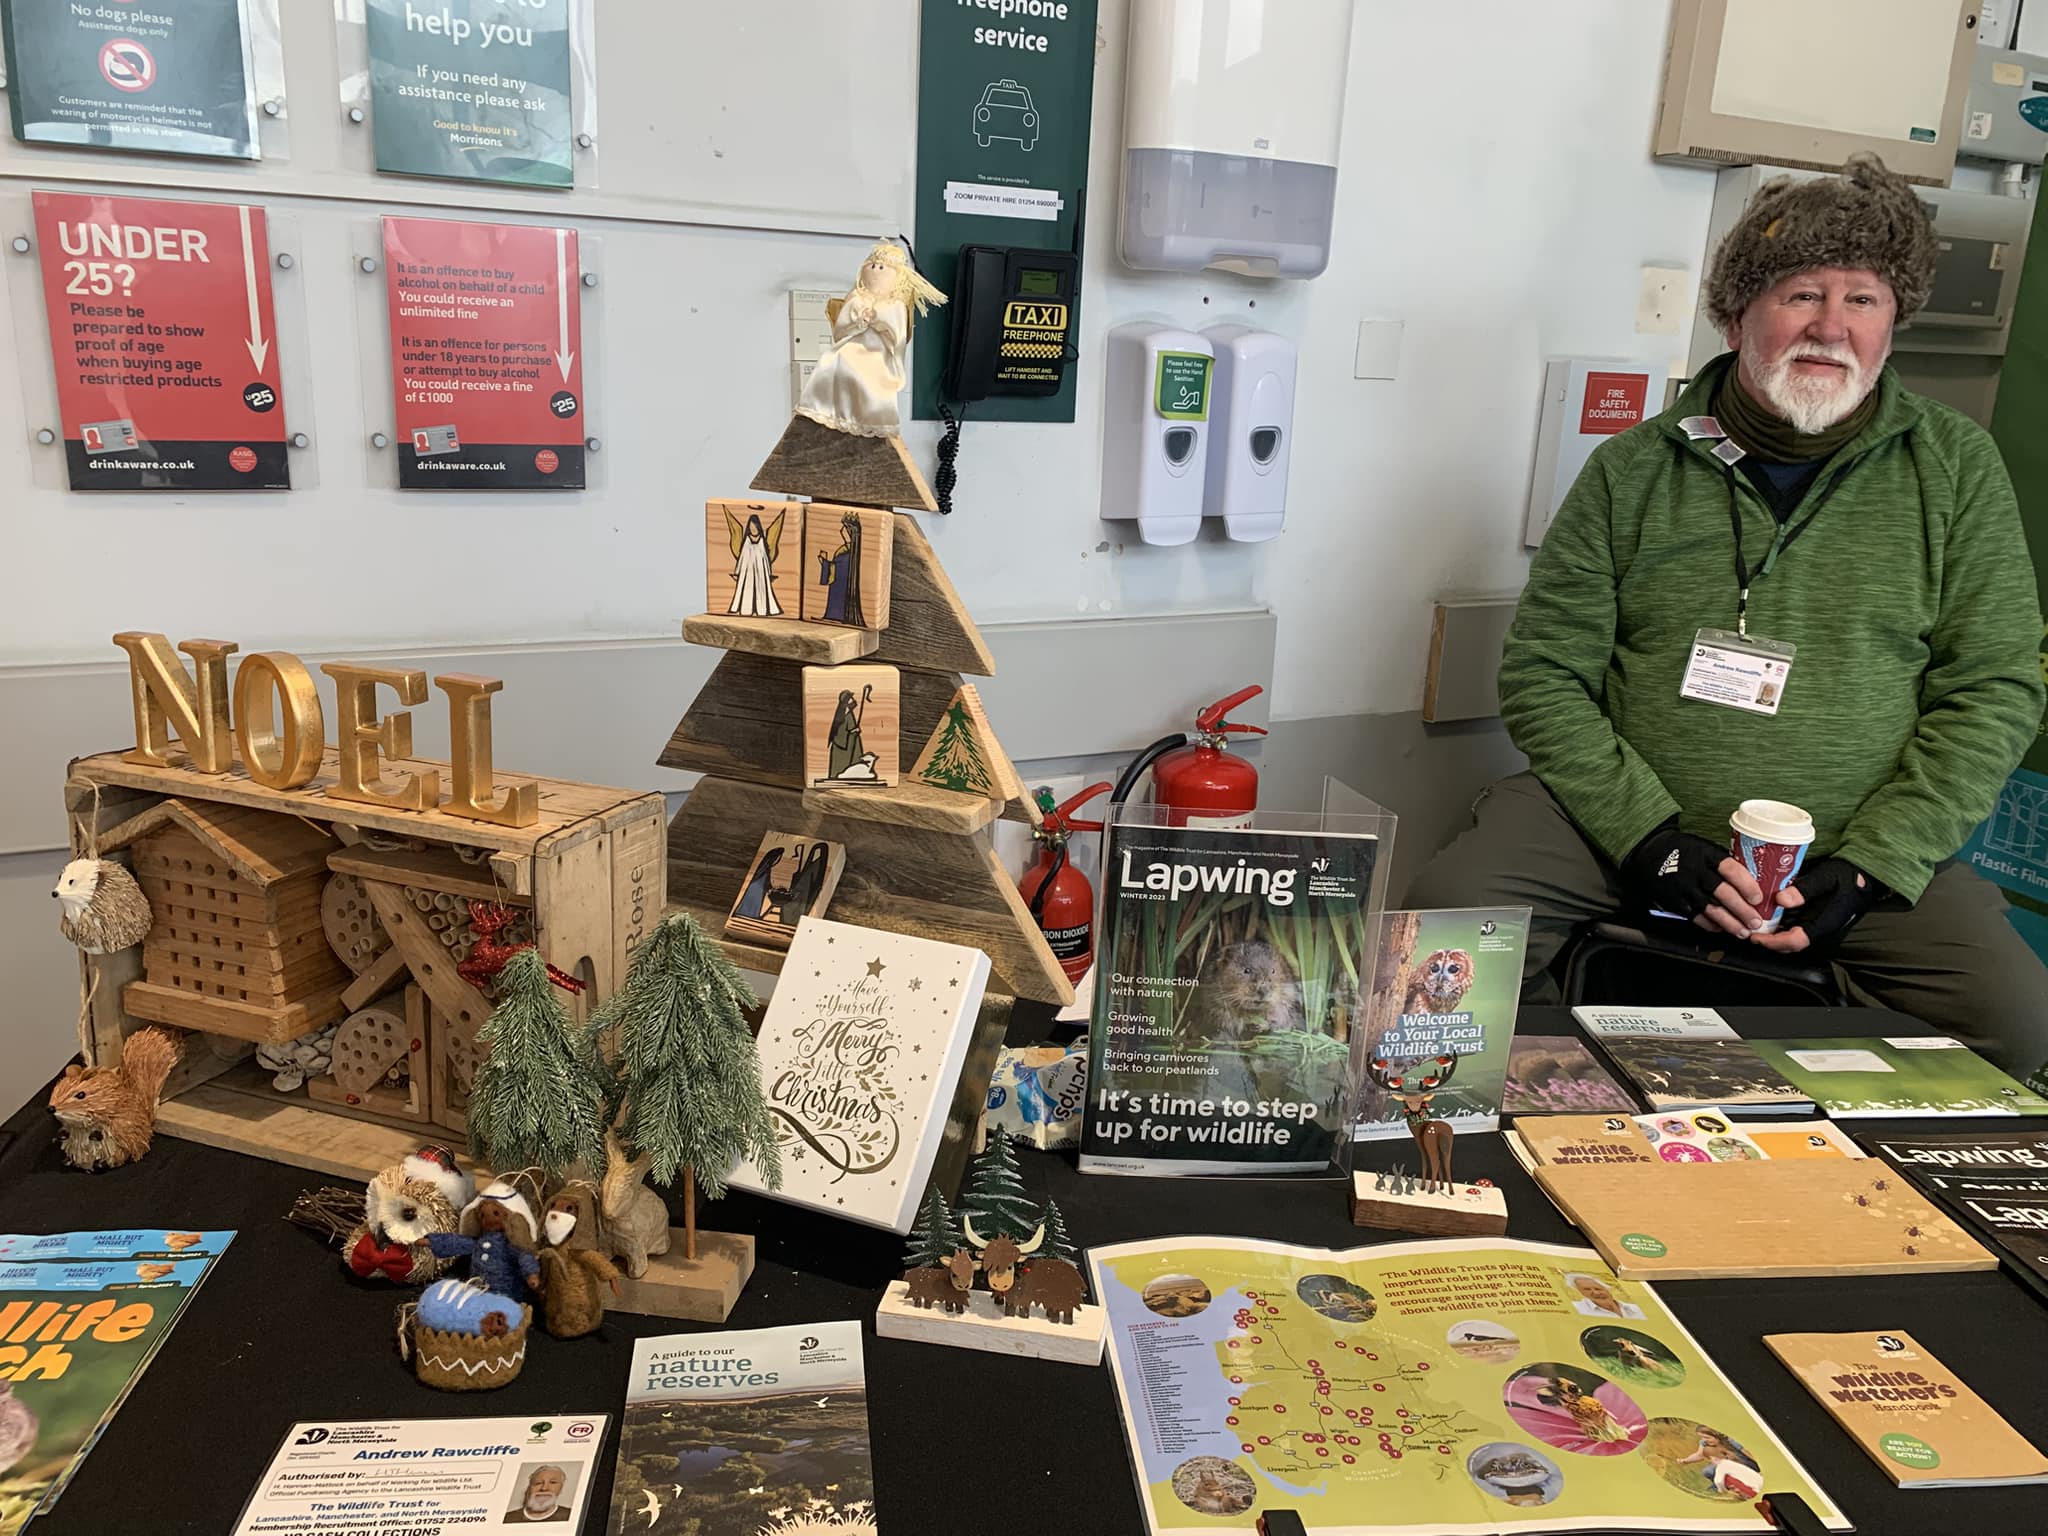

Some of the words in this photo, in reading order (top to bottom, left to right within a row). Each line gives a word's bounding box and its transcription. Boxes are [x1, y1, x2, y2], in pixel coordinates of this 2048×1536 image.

[71, 4, 91, 16] No
[95, 5, 127, 22] dogs
[131, 9, 173, 26] please
[78, 20, 124, 32] Assistance
[126, 24, 148, 36] dogs
[149, 28, 169, 39] only
[405, 3, 471, 46] help
[480, 21, 533, 48] you
[974, 26, 1049, 52] service
[416, 64, 428, 78] If
[431, 67, 459, 83] you
[463, 72, 498, 87] need
[502, 77, 527, 94] any
[398, 83, 472, 103] assistance
[475, 91, 520, 109] please
[524, 98, 546, 111] ask
[58, 95, 107, 108] Customers
[109, 100, 123, 109] are
[124, 101, 167, 114] reminded
[168, 105, 186, 115] that
[188, 107, 203, 117] the
[450, 133, 503, 147] Morrisons
[954, 192, 974, 201] ZOOM
[974, 194, 1001, 203] PRIVATE
[1002, 196, 1017, 205] HIRE
[59, 221, 210, 263] UNDER
[63, 261, 136, 297] 25?
[398, 291, 421, 303] You
[423, 292, 455, 305] could
[457, 294, 498, 307] receive
[500, 298, 514, 308] an
[70, 302, 123, 318] Please
[126, 304, 145, 319] be
[400, 306, 455, 319] unlimited
[456, 308, 479, 320] fine
[1013, 306, 1059, 325] TAXI
[72, 320, 144, 338] prepared
[147, 324, 162, 337] to
[165, 324, 205, 338] show
[1003, 330, 1064, 341] FREEPHONE
[75, 338, 116, 354] proof
[119, 339, 134, 352] of
[137, 343, 165, 355] age
[402, 336, 410, 347] It
[412, 338, 421, 348] is
[424, 339, 439, 349] an
[441, 337, 482, 350] offence
[484, 339, 500, 351] for
[503, 342, 547, 355] persons
[77, 356, 119, 369] when
[122, 357, 172, 372] buying
[175, 360, 203, 373] age
[79, 373, 154, 387] restricted
[157, 373, 223, 390] products
[1607, 389, 1625, 399] FIRE
[1599, 399, 1630, 409] SAFETY
[1588, 409, 1638, 420] DOCUMENTS
[89, 458, 195, 471] drinkaware.co.uk
[417, 461, 506, 472] drinkaware.co.uk
[113, 631, 538, 828] NOEL
[1971, 851, 2018, 877] Plastic
[1121, 849, 1298, 907] Lapwing
[1120, 892, 1148, 901] WINTER
[1044, 930, 1061, 940] BON
[1062, 923, 1089, 939] DIOXIDE
[850, 977, 879, 997] Have
[1112, 972, 1134, 984] Our
[1136, 974, 1200, 988] connection
[1110, 985, 1135, 997] with
[1137, 986, 1174, 998] nature
[826, 995, 890, 1016] Yourself
[1107, 1011, 1156, 1025] Growing
[1402, 1011, 1470, 1027] Welcome
[1597, 1016, 1660, 1027] nature
[1106, 1025, 1135, 1036] good
[1138, 1026, 1173, 1037] health
[1384, 1029, 1400, 1043] to
[1404, 1026, 1440, 1042] Your
[1442, 1024, 1483, 1040] Local
[1601, 1024, 1683, 1035] reserves
[794, 1018, 899, 1066] Merry
[1377, 1043, 1440, 1058] Wildlife
[1442, 1039, 1486, 1054] Trust
[1104, 1048, 1150, 1063] Bringing
[1153, 1050, 1209, 1063] carnivores
[810, 1060, 852, 1083] Little
[1102, 1061, 1129, 1072] back
[1132, 1063, 1142, 1073] to
[1145, 1065, 1163, 1074] our
[1165, 1064, 1220, 1076] peatlands
[769, 1070, 882, 1123] Christmas
[1150, 1092, 1215, 1117] time
[1221, 1095, 1250, 1118] to
[1255, 1096, 1319, 1126] step
[1095, 1120, 1133, 1145] up
[1139, 1118, 1181, 1142] for
[1186, 1121, 1291, 1146] wildlife
[1880, 1144, 2048, 1169] Lapwing
[1408, 1266, 1457, 1278] Wildlife
[1458, 1263, 1497, 1273] Trusts
[1499, 1263, 1525, 1273] play
[650, 1351, 660, 1361] A
[662, 1349, 696, 1361] guide
[698, 1348, 712, 1356] to
[714, 1348, 735, 1356] our
[648, 1357, 753, 1376] nature
[1853, 1362, 1879, 1371] The
[645, 1371, 779, 1391] reserves
[1872, 1402, 1942, 1412] Handbook
[353, 1449, 429, 1461] Andrew
[431, 1445, 521, 1458] Rawcliffe
[278, 1472, 345, 1481] Authorised
[347, 1471, 367, 1480] by:
[310, 1503, 335, 1511] The
[337, 1501, 386, 1510] Wildlife
[389, 1500, 424, 1508] Trust
[249, 1522, 312, 1532] Membership
[313, 1520, 380, 1530] Recruitment
[380, 1519, 414, 1527] Office:
[414, 1517, 446, 1525] 01752
[447, 1516, 488, 1524] 224096
